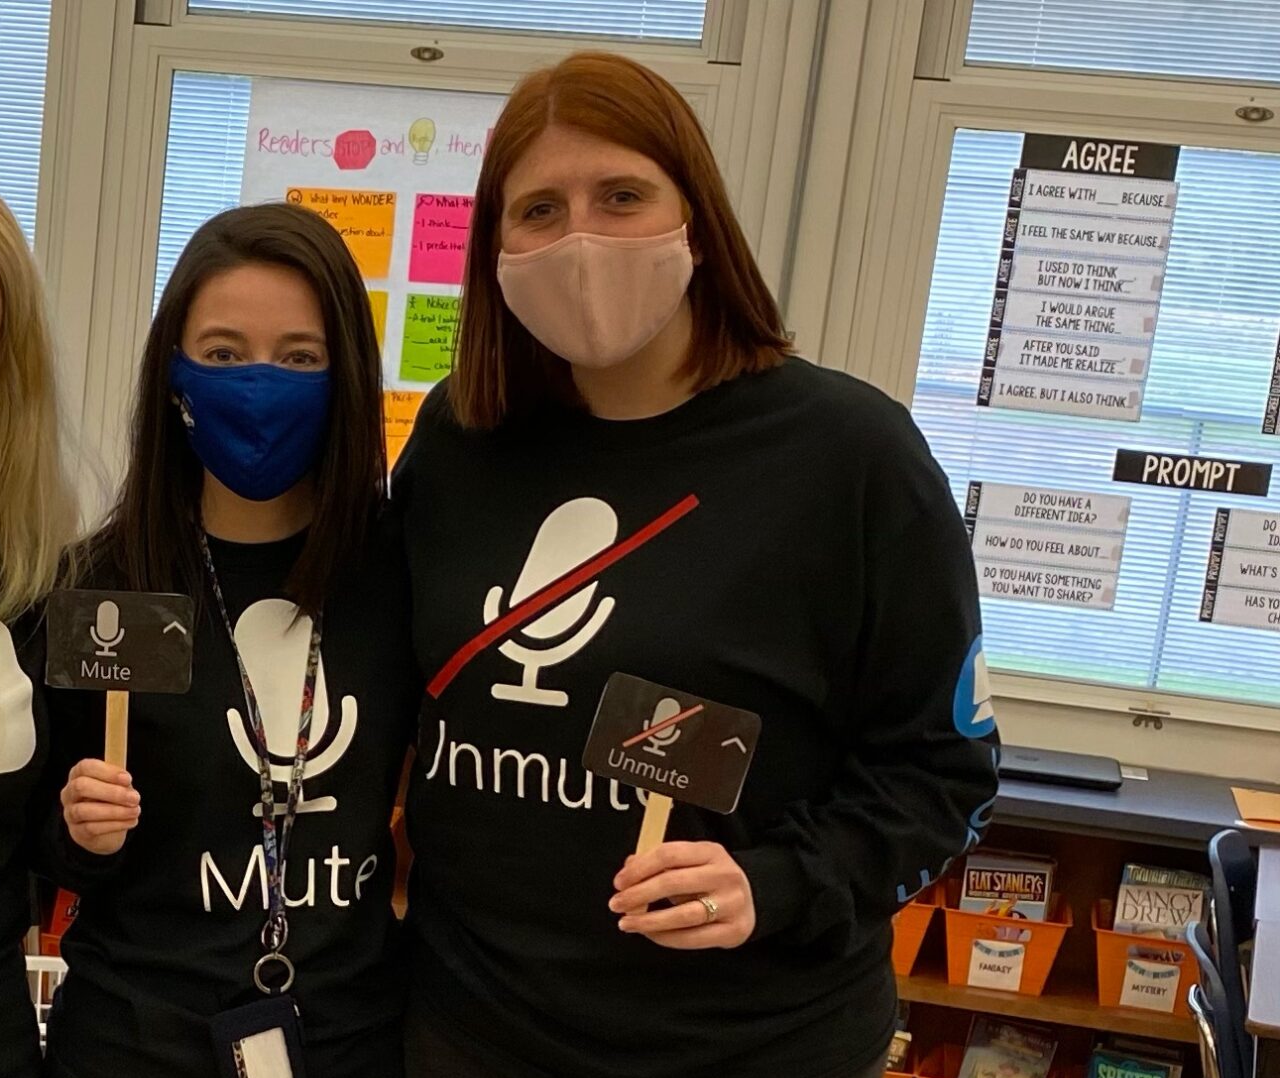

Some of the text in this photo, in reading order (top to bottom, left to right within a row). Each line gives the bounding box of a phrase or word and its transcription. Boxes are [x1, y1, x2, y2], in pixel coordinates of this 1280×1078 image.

[258, 128, 333, 157] Readers
[380, 134, 404, 155] and
[1061, 140, 1139, 175] AGREE
[352, 193, 394, 206] WONDER
[1028, 184, 1034, 196] I
[1036, 185, 1066, 199] AGREE
[1068, 187, 1096, 201] WITH
[1005, 217, 1018, 242] AGREE
[1022, 224, 1027, 236] I
[1028, 225, 1048, 238] FEEL
[1051, 227, 1067, 239] THE
[1070, 229, 1094, 242] SAME
[1097, 231, 1116, 243] WAY
[999, 258, 1012, 283] AGREE
[1039, 260, 1119, 278] I USED TO THINK
[1038, 274, 1057, 286] BUT
[1058, 276, 1083, 288] NOW
[1084, 278, 1089, 290] I
[1040, 301, 1116, 319] I WOULD ARGUE
[1036, 315, 1053, 328] THE
[1056, 317, 1080, 330] SAME
[986, 336, 999, 362] AGREE
[1023, 339, 1100, 358] AFTER YOU SAID
[1019, 354, 1116, 374] IT MADE ME REALIZE
[979, 376, 992, 400] AGREE
[999, 383, 1004, 396] I
[1040, 388, 1059, 400] BUT
[1060, 390, 1066, 401] I
[1068, 391, 1094, 404] ALSO
[1263, 396, 1280, 432] DISAGREE
[1142, 454, 1242, 492] PROMPT
[967, 486, 980, 514] PROMPT
[1023, 492, 1092, 510] DO YOU HAVE A
[1014, 505, 1097, 524] DIFFERENT IDEA?
[1214, 512, 1228, 542] PROMPT
[1263, 519, 1277, 532] DO
[985, 535, 1009, 547] HOW
[1010, 538, 1023, 549] DO
[1026, 540, 1044, 552] YOU
[1044, 542, 1065, 554] FEEL
[1208, 550, 1222, 580] PROMPT
[1240, 563, 1278, 578] WHAT'S
[984, 566, 1102, 590] DO YOU HAVE SOMETHING
[992, 581, 1093, 602] YOU WANT TO SHARE?
[1244, 595, 1266, 608] HAS
[1201, 589, 1216, 618] PROMPT
[81, 661, 131, 680] Mute
[426, 720, 674, 811] nmu
[608, 748, 690, 790] Unmute
[200, 844, 378, 913] Mute
[970, 870, 992, 891] FLAT
[1126, 888, 1200, 912] NANCY
[1122, 902, 1192, 926] DREW
[979, 962, 1014, 974] FANTASY
[1132, 983, 1168, 996] MYSTERY
